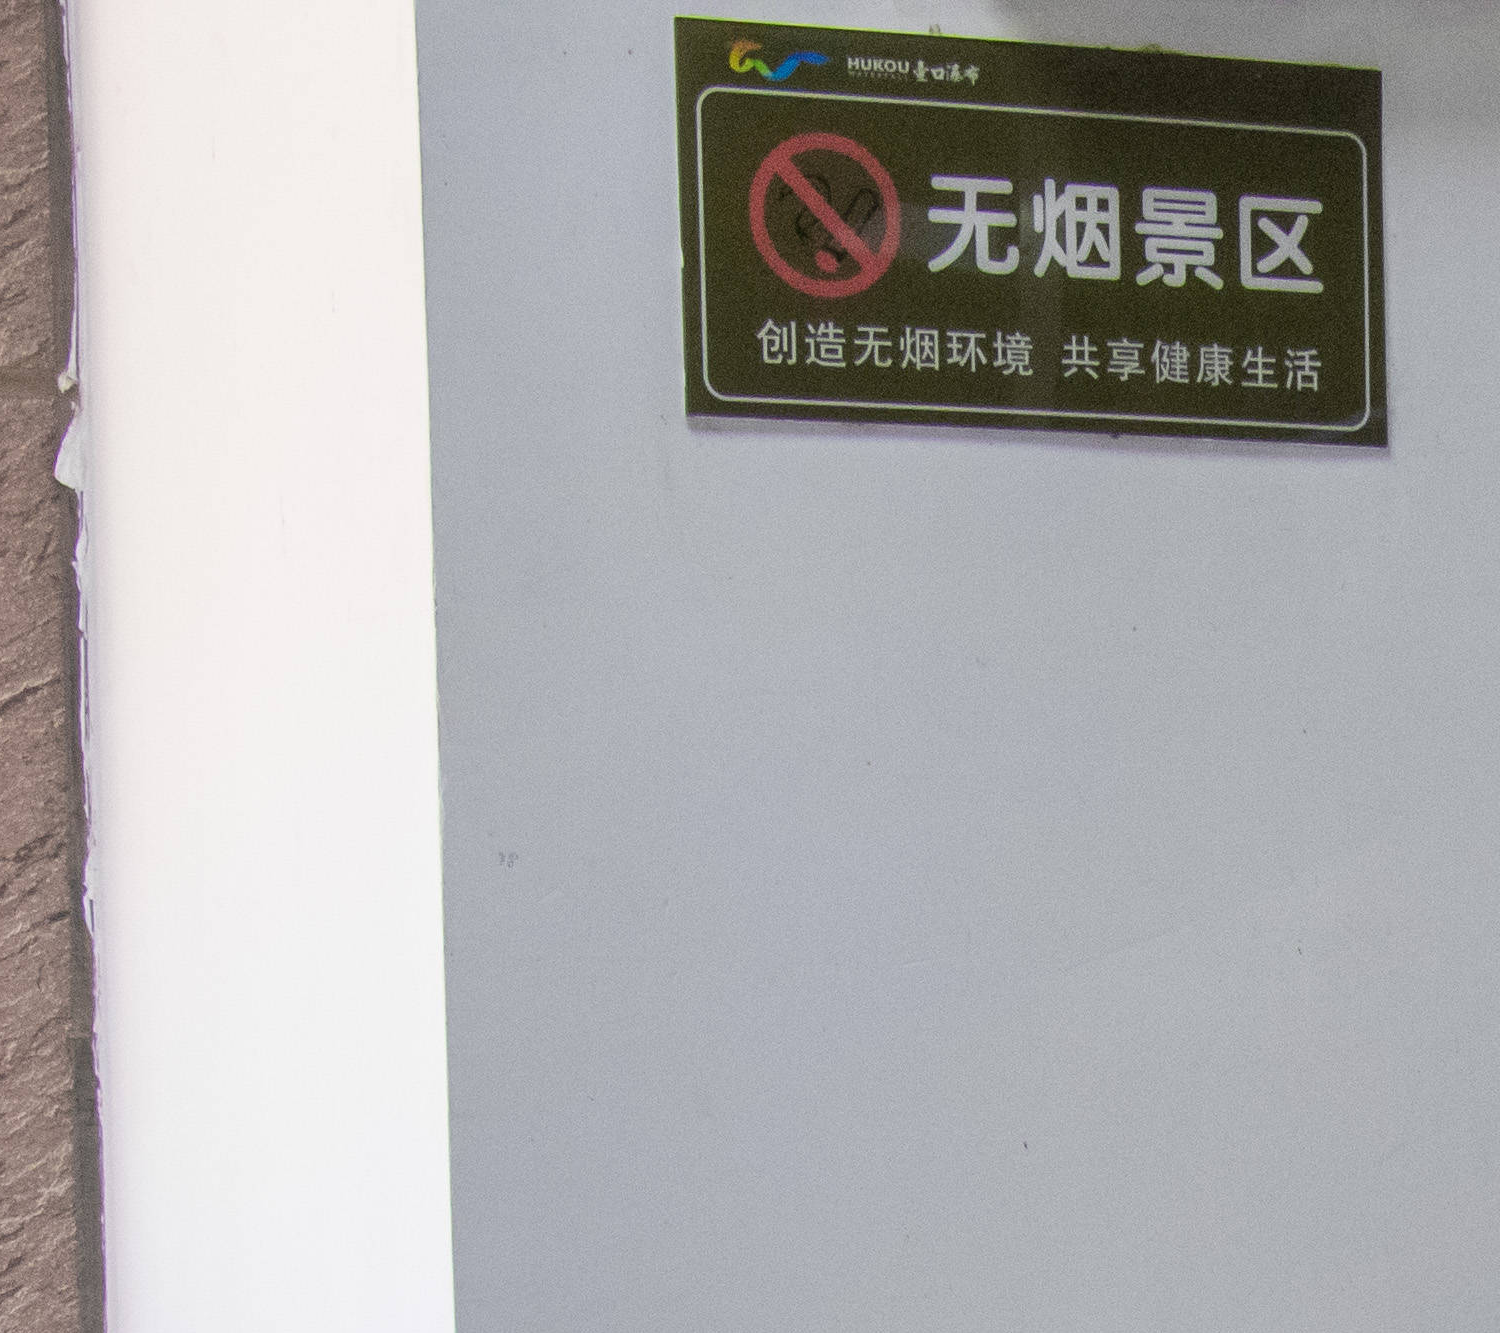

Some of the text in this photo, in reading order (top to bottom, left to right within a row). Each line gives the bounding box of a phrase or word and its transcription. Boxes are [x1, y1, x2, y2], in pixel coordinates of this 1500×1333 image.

[847, 56, 910, 73] HUKOU
[926, 173, 1324, 294] 无烟景区
[755, 318, 1323, 392] 创造无烟环境 共享健康生活
